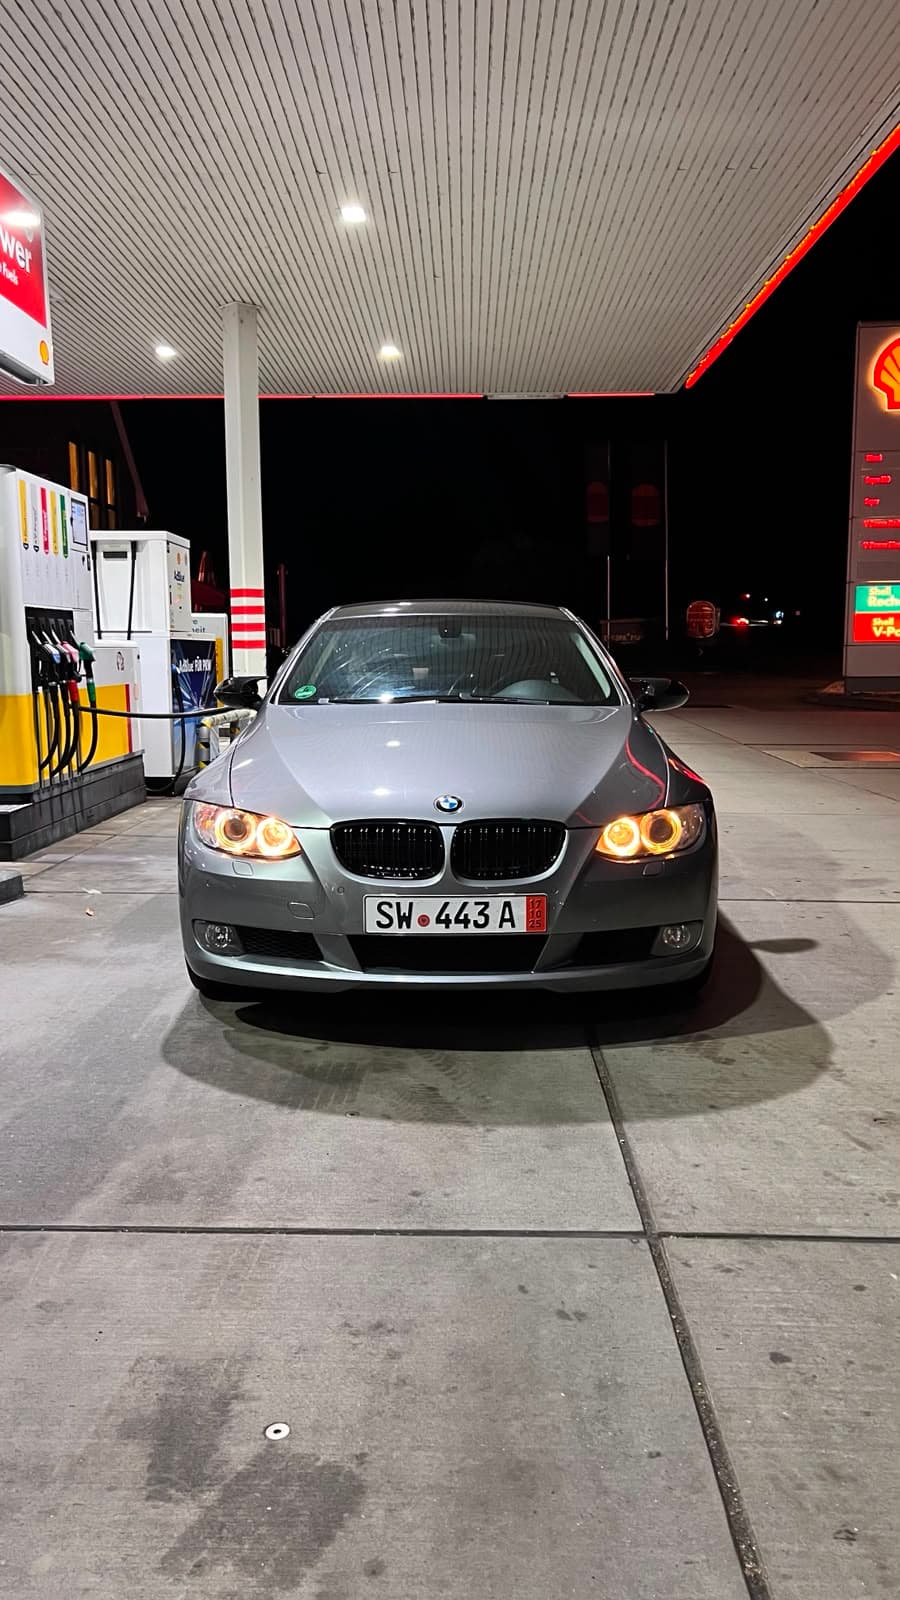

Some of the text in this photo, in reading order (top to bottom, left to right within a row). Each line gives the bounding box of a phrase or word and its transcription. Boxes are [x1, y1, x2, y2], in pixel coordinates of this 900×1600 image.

[872, 617, 895, 626] Shell
[529, 900, 541, 909] 17
[376, 901, 516, 929] SW 443 A
[529, 910, 541, 918] 10
[529, 920, 541, 928] 25
